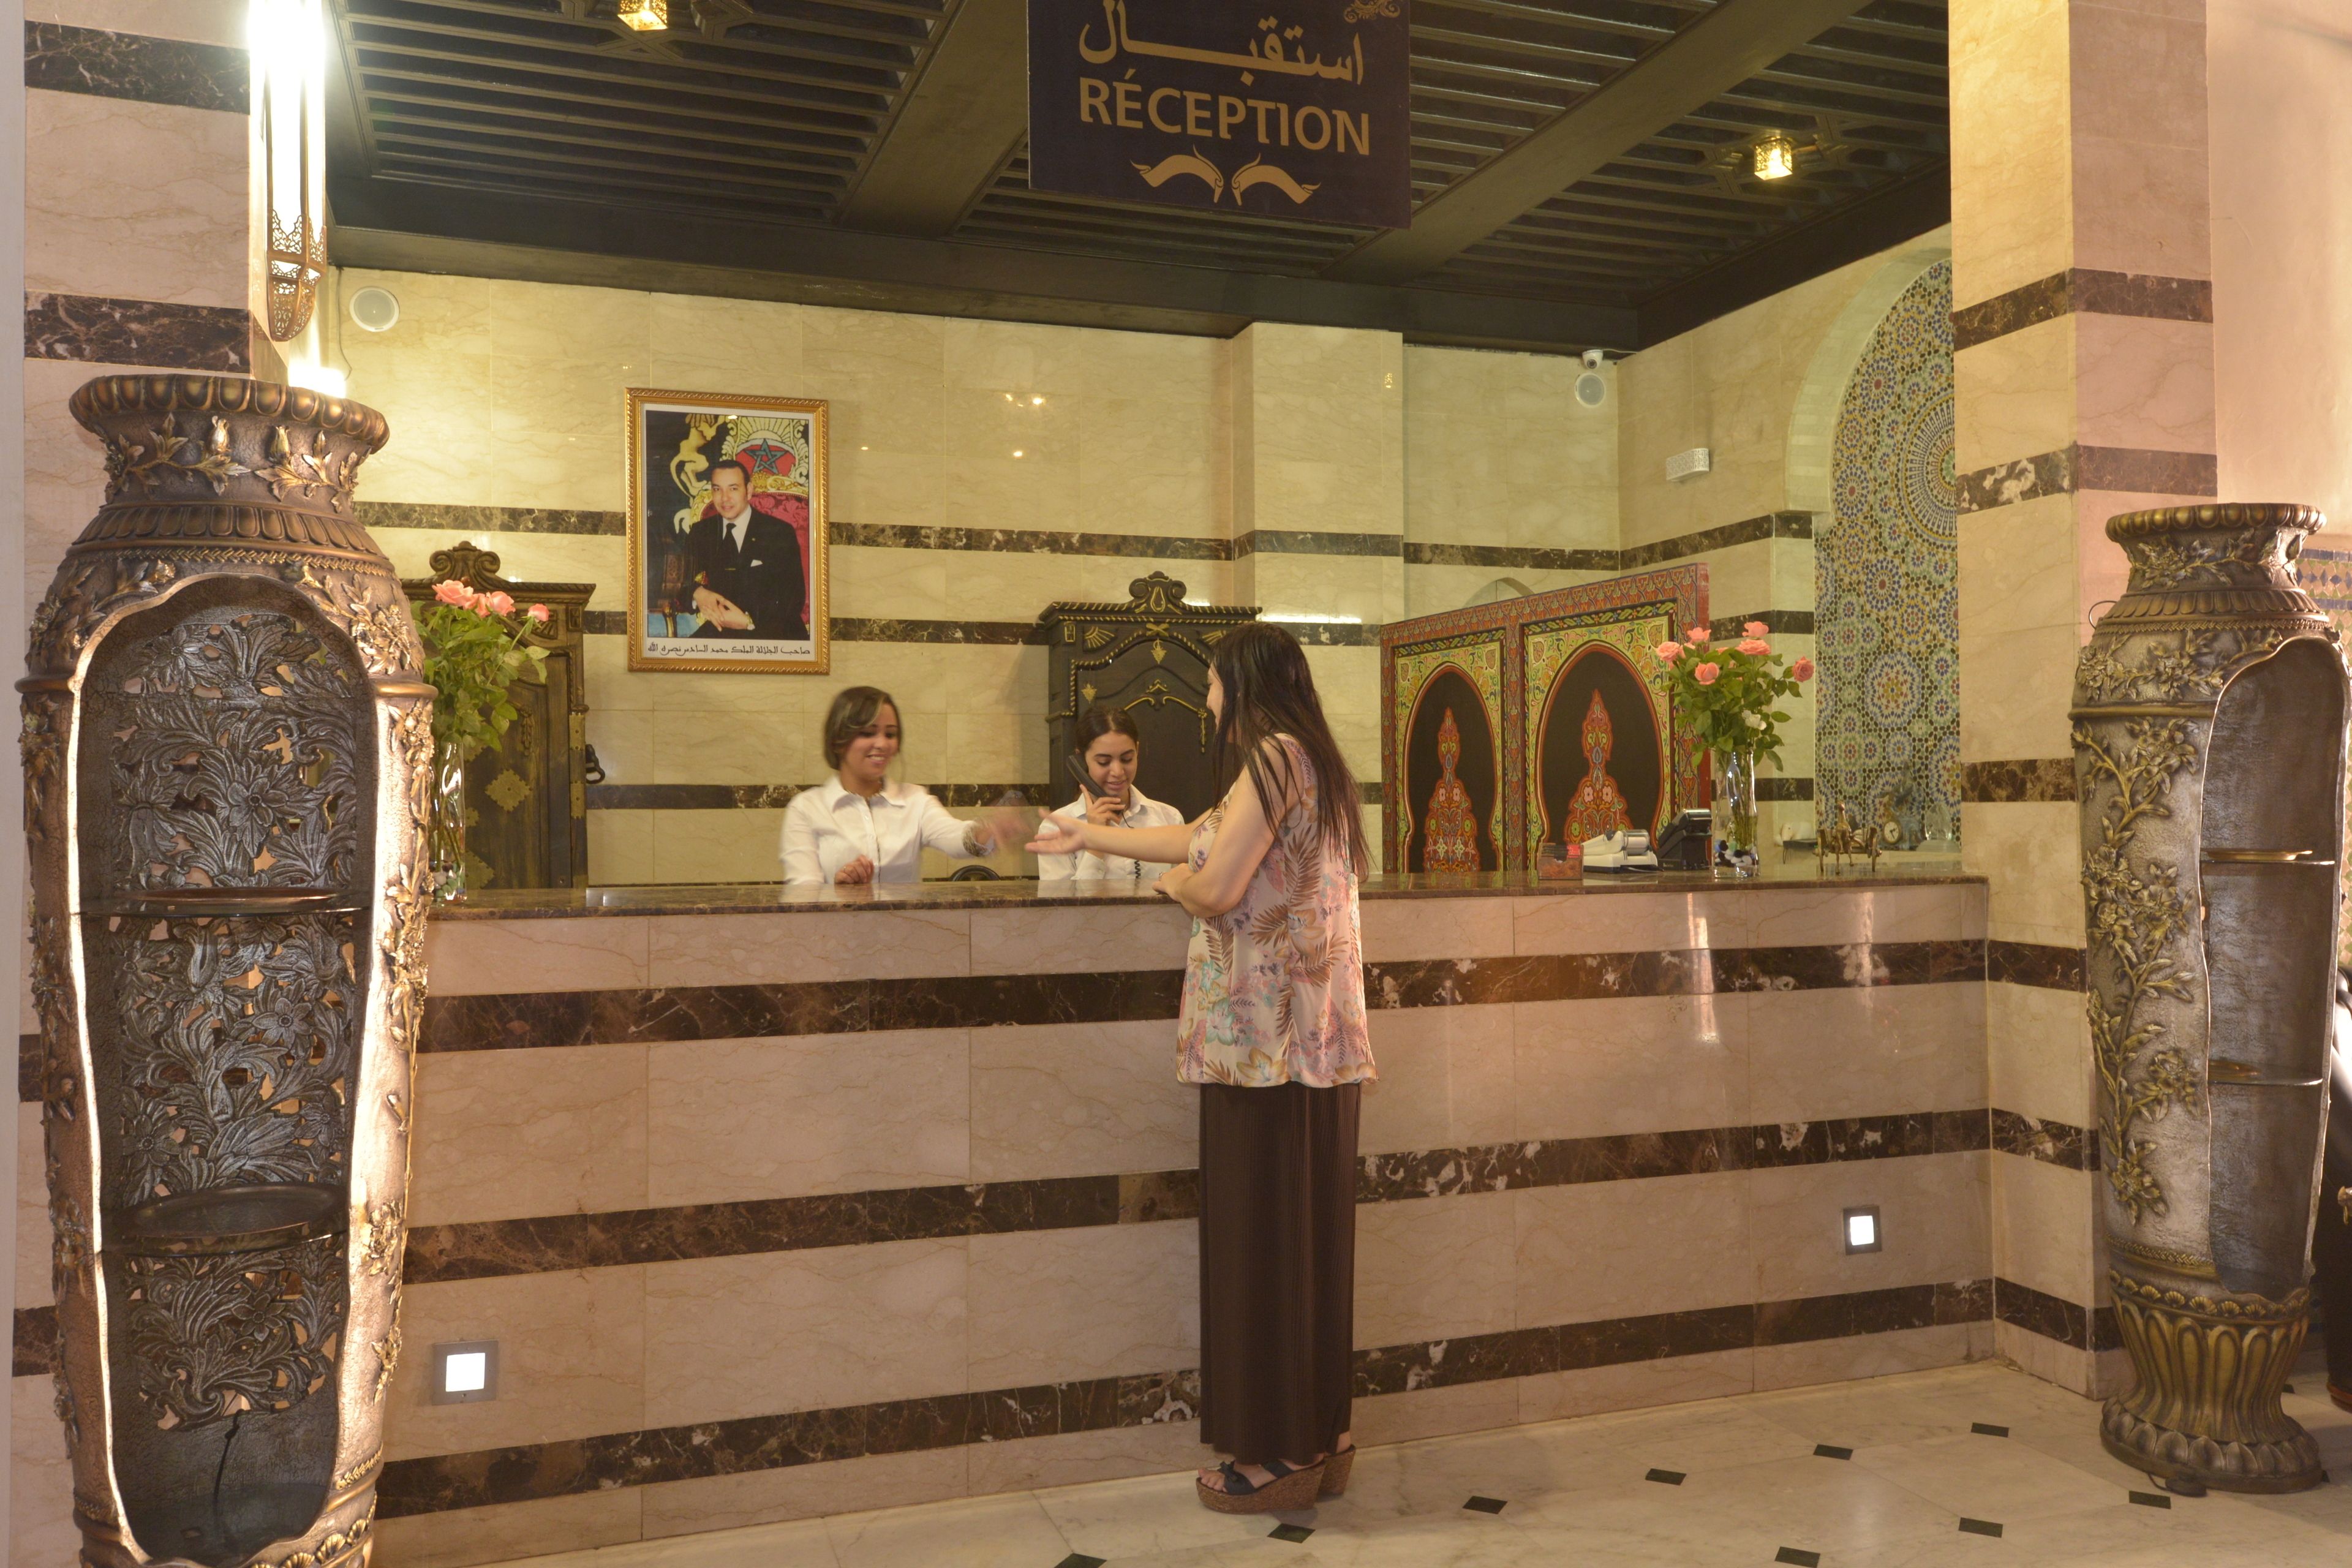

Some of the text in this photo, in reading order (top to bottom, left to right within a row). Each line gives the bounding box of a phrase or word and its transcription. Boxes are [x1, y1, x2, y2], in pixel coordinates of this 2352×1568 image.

[1079, 0, 1363, 86] استقبال
[1080, 69, 1370, 156] RÉCEPTION
[648, 642, 658, 652] الله
[660, 646, 681, 655] نصره
[675, 645, 708, 657] السادس
[731, 645, 753, 654] الملك
[756, 646, 778, 655] الجلالة
[780, 646, 810, 655] صاحب
